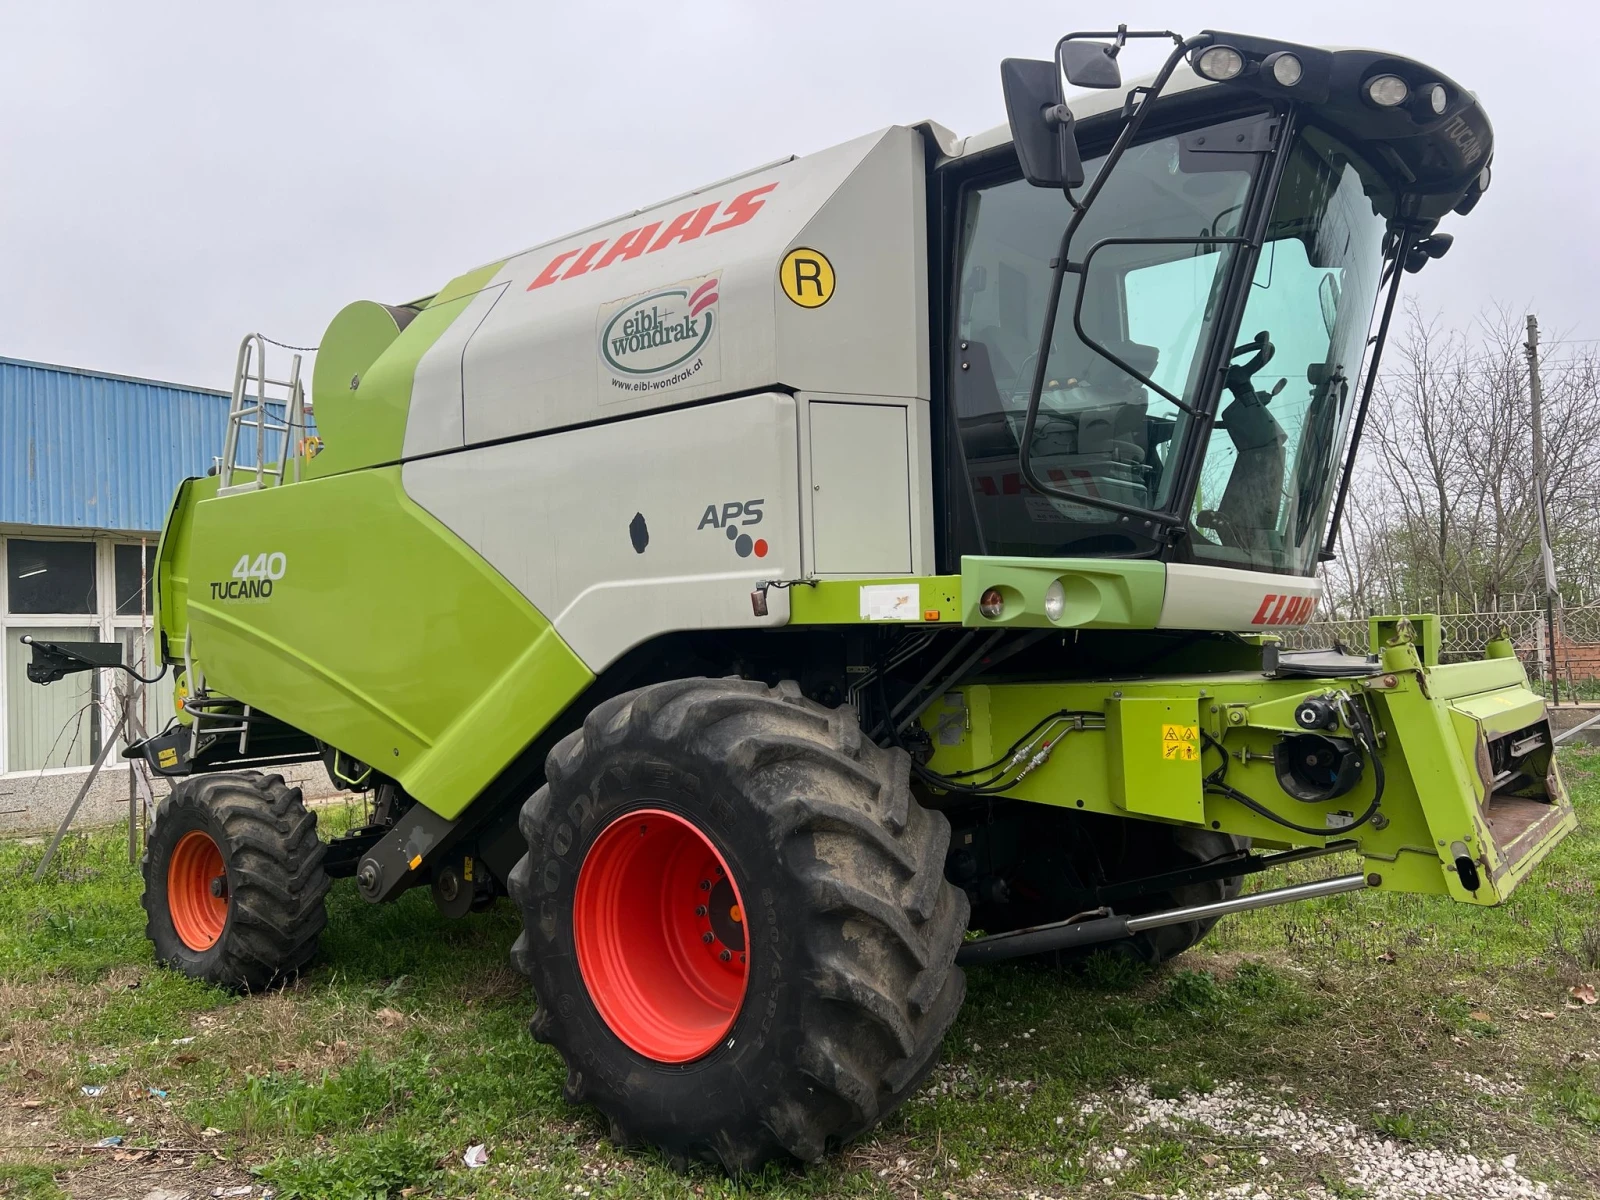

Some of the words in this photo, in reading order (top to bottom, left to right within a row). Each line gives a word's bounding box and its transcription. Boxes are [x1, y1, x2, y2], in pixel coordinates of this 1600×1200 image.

[1445, 116, 1481, 164] TUCANO
[526, 182, 779, 291] CLAAS
[795, 258, 823, 296] R
[612, 315, 698, 356] wondrak
[612, 359, 703, 391] www.eibl-wondrak.at
[697, 498, 764, 530] APS
[232, 552, 286, 581] 440
[211, 579, 272, 600] TUCANO
